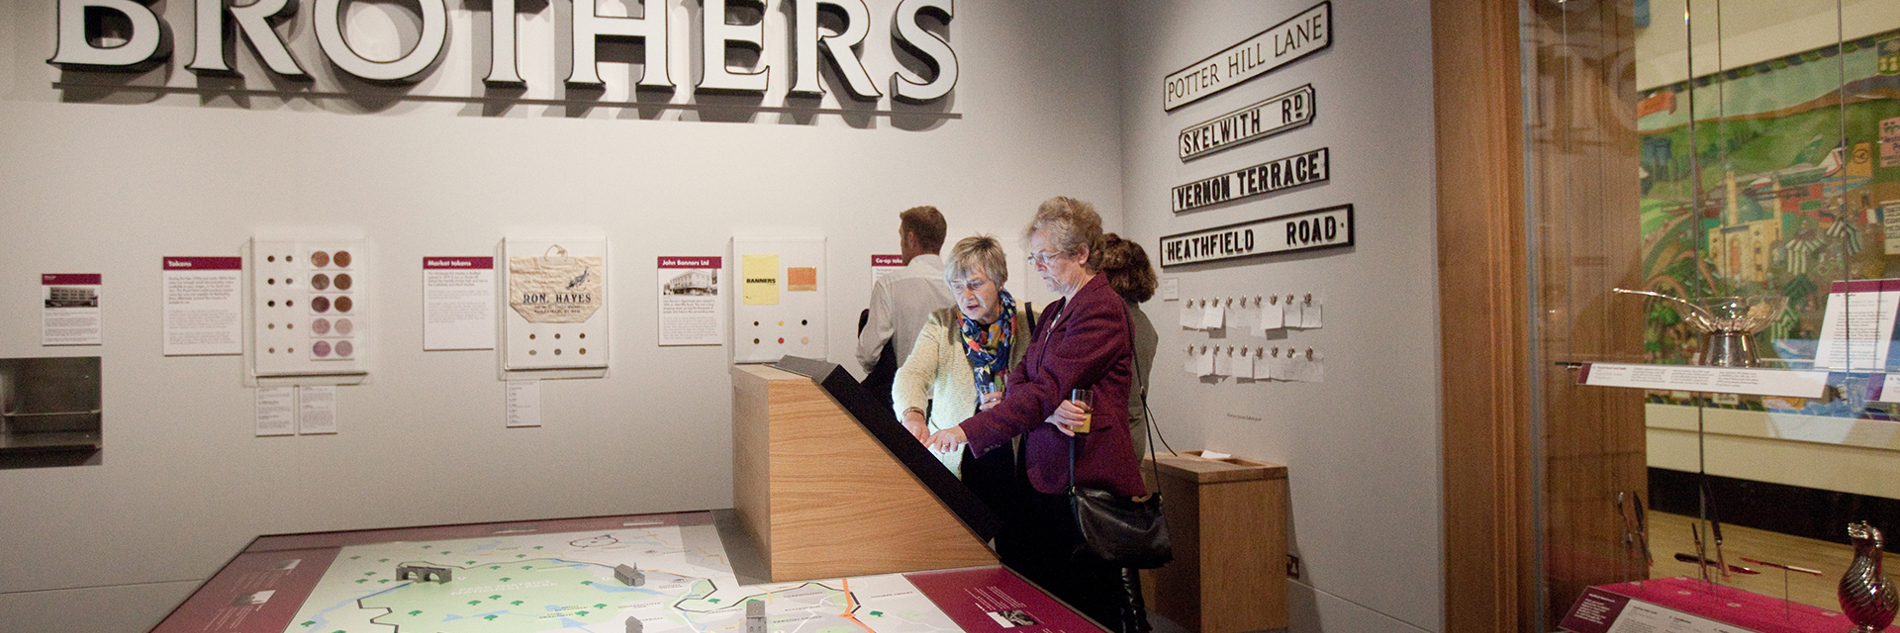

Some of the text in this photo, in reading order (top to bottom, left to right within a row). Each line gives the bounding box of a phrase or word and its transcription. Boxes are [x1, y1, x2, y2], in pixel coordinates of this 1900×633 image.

[1168, 14, 1322, 103] POTTER HILL LANE
[1184, 109, 1261, 154] SKELWITH
[1177, 151, 1320, 209] VERNON TERRACE
[1167, 215, 1337, 262] HEATHFIELD ROAD
[168, 259, 192, 267] Tokens
[451, 259, 472, 267] tokens
[556, 292, 592, 304] HAYES
